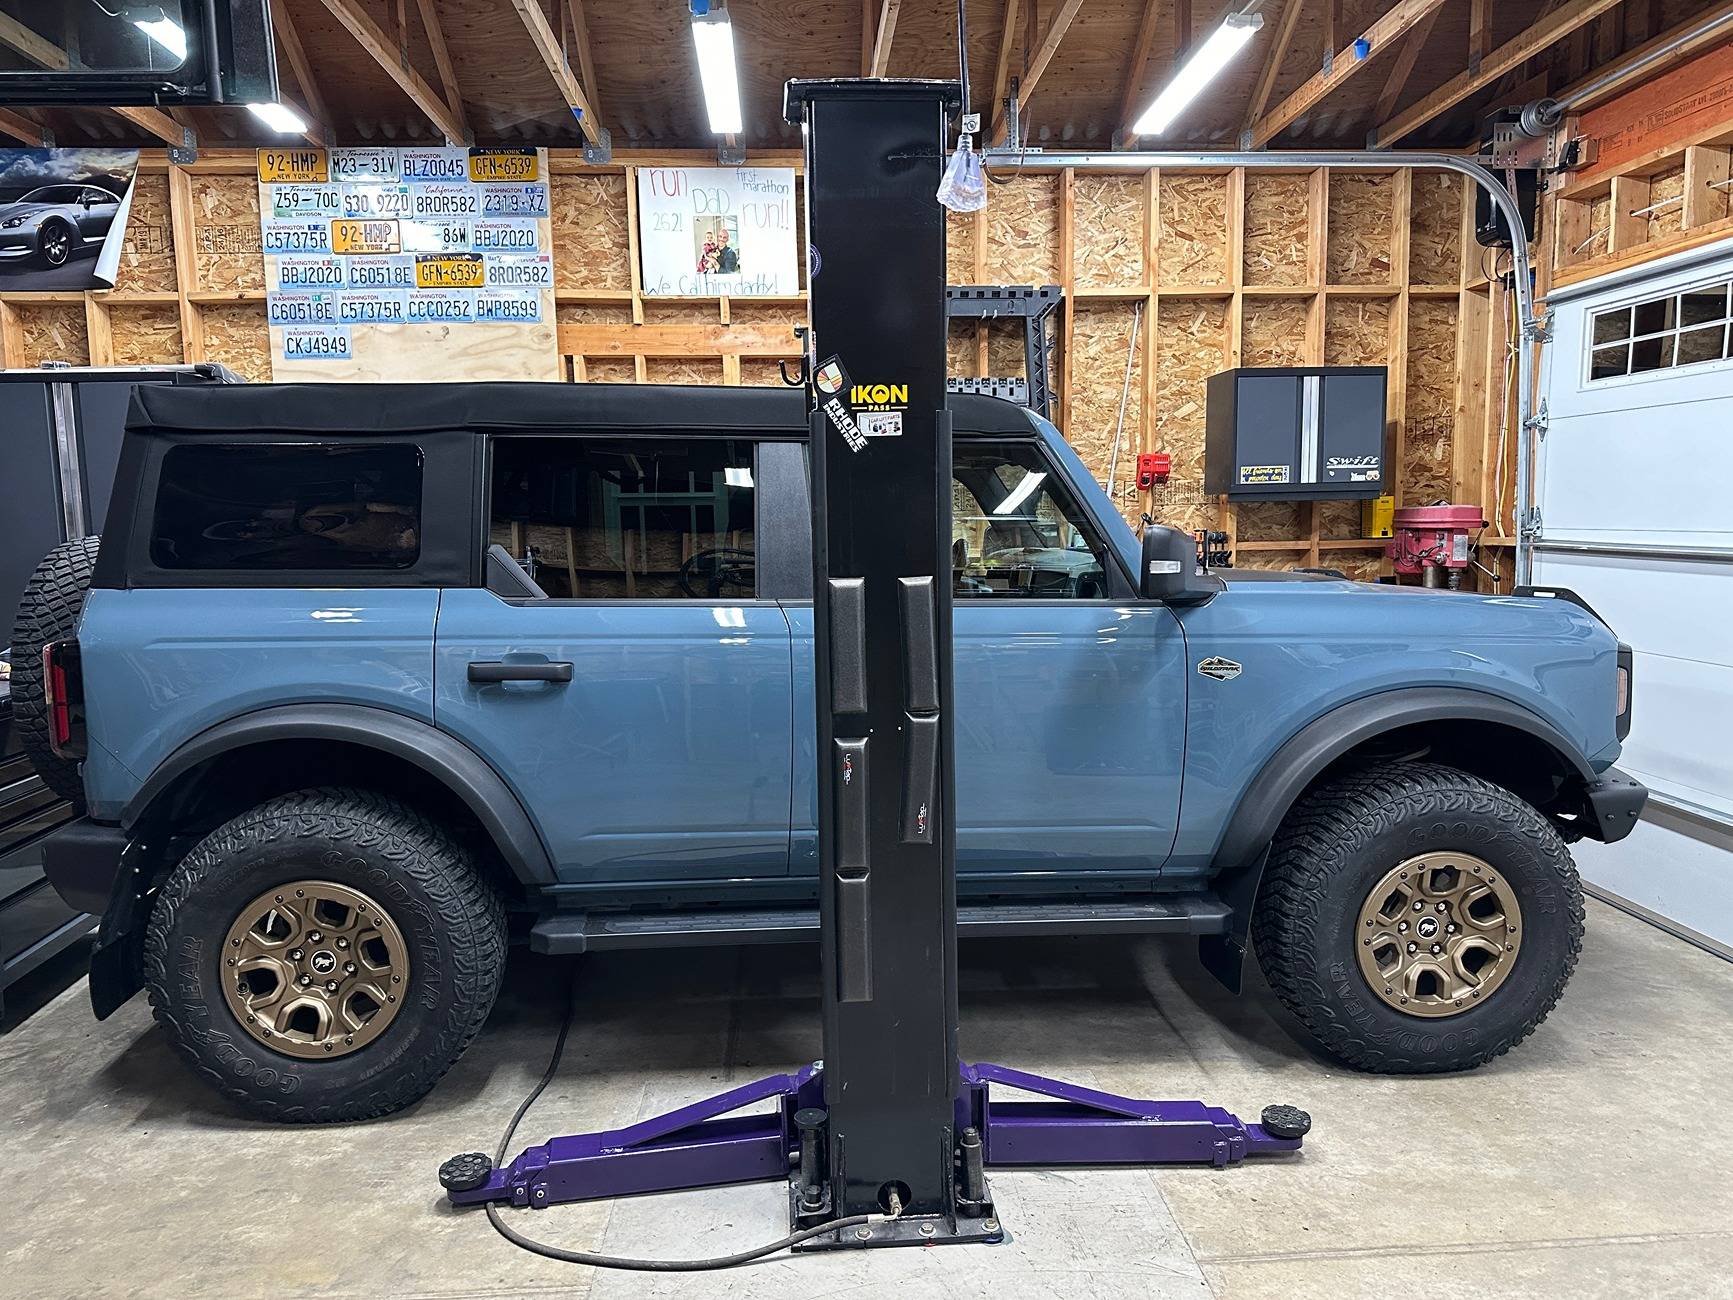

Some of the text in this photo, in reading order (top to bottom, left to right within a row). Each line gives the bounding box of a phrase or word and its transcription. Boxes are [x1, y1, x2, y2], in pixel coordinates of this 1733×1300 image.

[267, 152, 318, 172] 92-HMP
[332, 158, 395, 174] M23-31V
[404, 159, 464, 176] BLZ0045
[650, 168, 688, 197] run
[736, 168, 758, 182] first
[425, 185, 464, 195] California
[742, 179, 790, 196] marathon
[276, 192, 339, 208] Z59-70C
[742, 199, 790, 230] run!!
[266, 232, 327, 249] C57375R
[340, 223, 392, 242] 92-HMP
[474, 230, 534, 246] BBJ2020
[282, 266, 342, 284] BBJ2020
[350, 266, 412, 284] C60518E
[644, 274, 671, 296] We
[704, 274, 732, 296] him
[272, 303, 332, 320] C60518E
[340, 302, 401, 318] C57375R
[408, 301, 470, 318] CCC0252
[477, 300, 538, 318] BWP8599
[286, 336, 346, 354] CKJ4949
[850, 384, 908, 404] IKON
[822, 404, 860, 453] INDUSTRIES
[828, 397, 868, 449] RHODE
